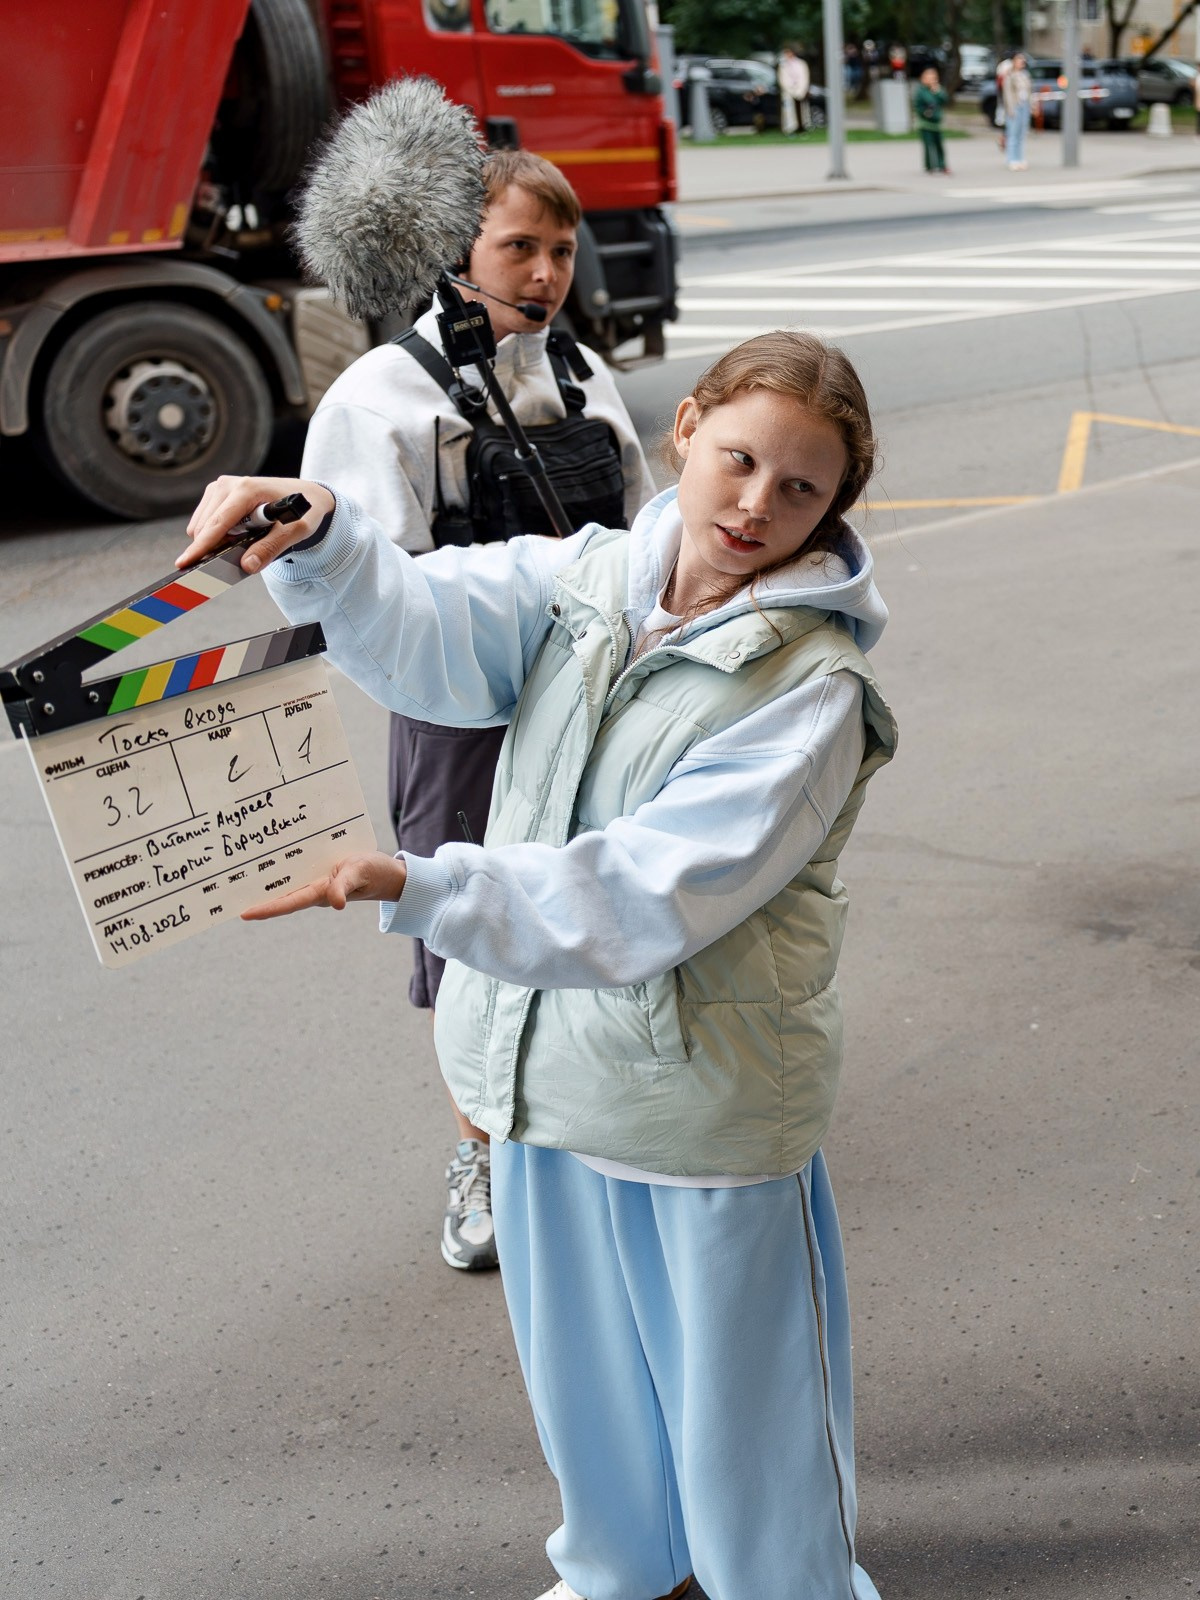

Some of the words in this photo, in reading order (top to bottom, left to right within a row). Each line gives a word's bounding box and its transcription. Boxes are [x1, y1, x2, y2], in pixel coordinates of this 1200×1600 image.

[184, 702, 236, 729] входа
[284, 701, 313, 718] ДУБЛЬ
[207, 726, 232, 742] КАДР
[298, 727, 312, 764] 1
[44, 756, 86, 776] ФИЛЬМ
[96, 760, 131, 779] СЦЕНА
[103, 786, 154, 826] 3.2
[146, 821, 211, 857] Виталий
[216, 791, 273, 828] Андреев
[152, 846, 214, 886] Георгий
[221, 804, 307, 857] Борщевский
[330, 829, 348, 841] ЗВУК
[284, 847, 304, 860] НОЧЬ
[83, 853, 143, 882] РЕЖИССЁР:
[257, 858, 276, 872] ДЕНЬ
[202, 882, 220, 894] ИНТ.
[264, 875, 292, 892] ФИЛЬТР
[93, 880, 151, 908] ОПЕРАТОР:
[209, 904, 224, 916] FPS
[103, 917, 135, 938] ДАТА:
[109, 904, 191, 954] 14.08.2026
